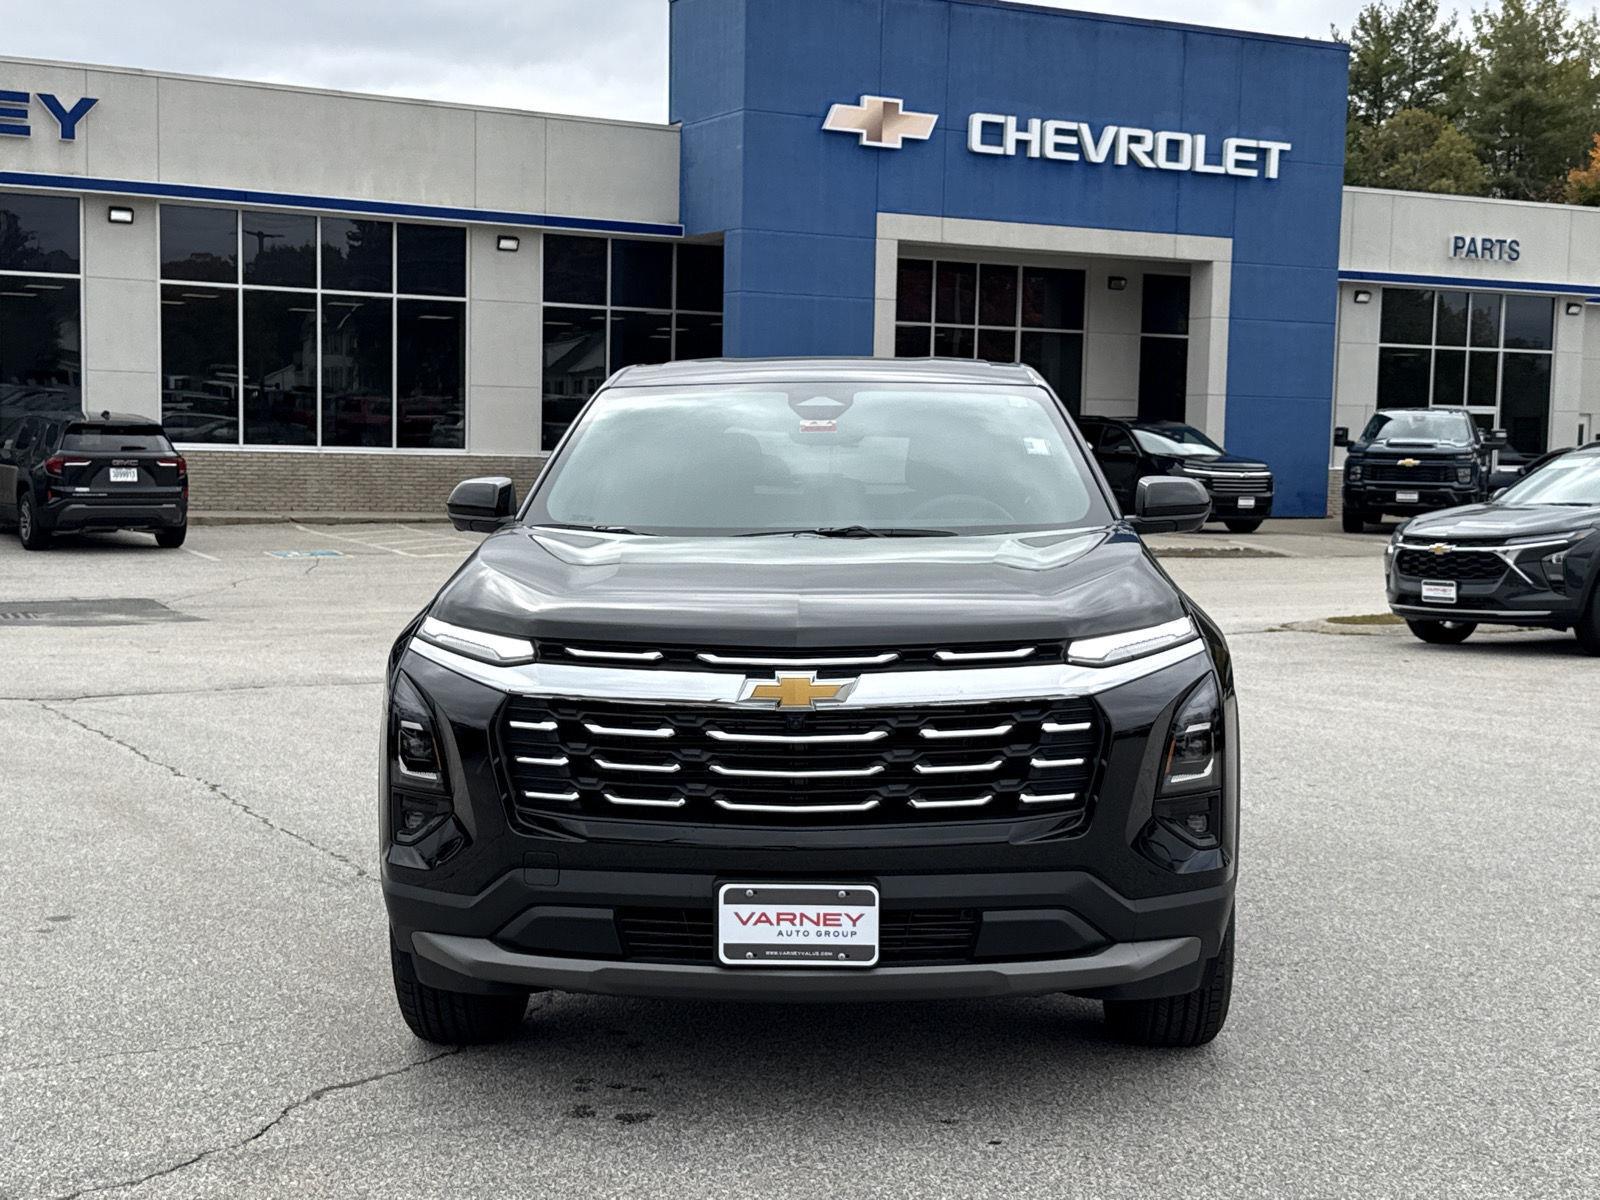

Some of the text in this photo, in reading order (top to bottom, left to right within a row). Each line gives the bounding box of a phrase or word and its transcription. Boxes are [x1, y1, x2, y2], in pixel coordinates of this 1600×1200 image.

[967, 112, 1292, 179] CHEVROLET
[1450, 235, 1520, 261] PARTS
[733, 911, 865, 927] VARNEY
[816, 930, 858, 938] GROUP
